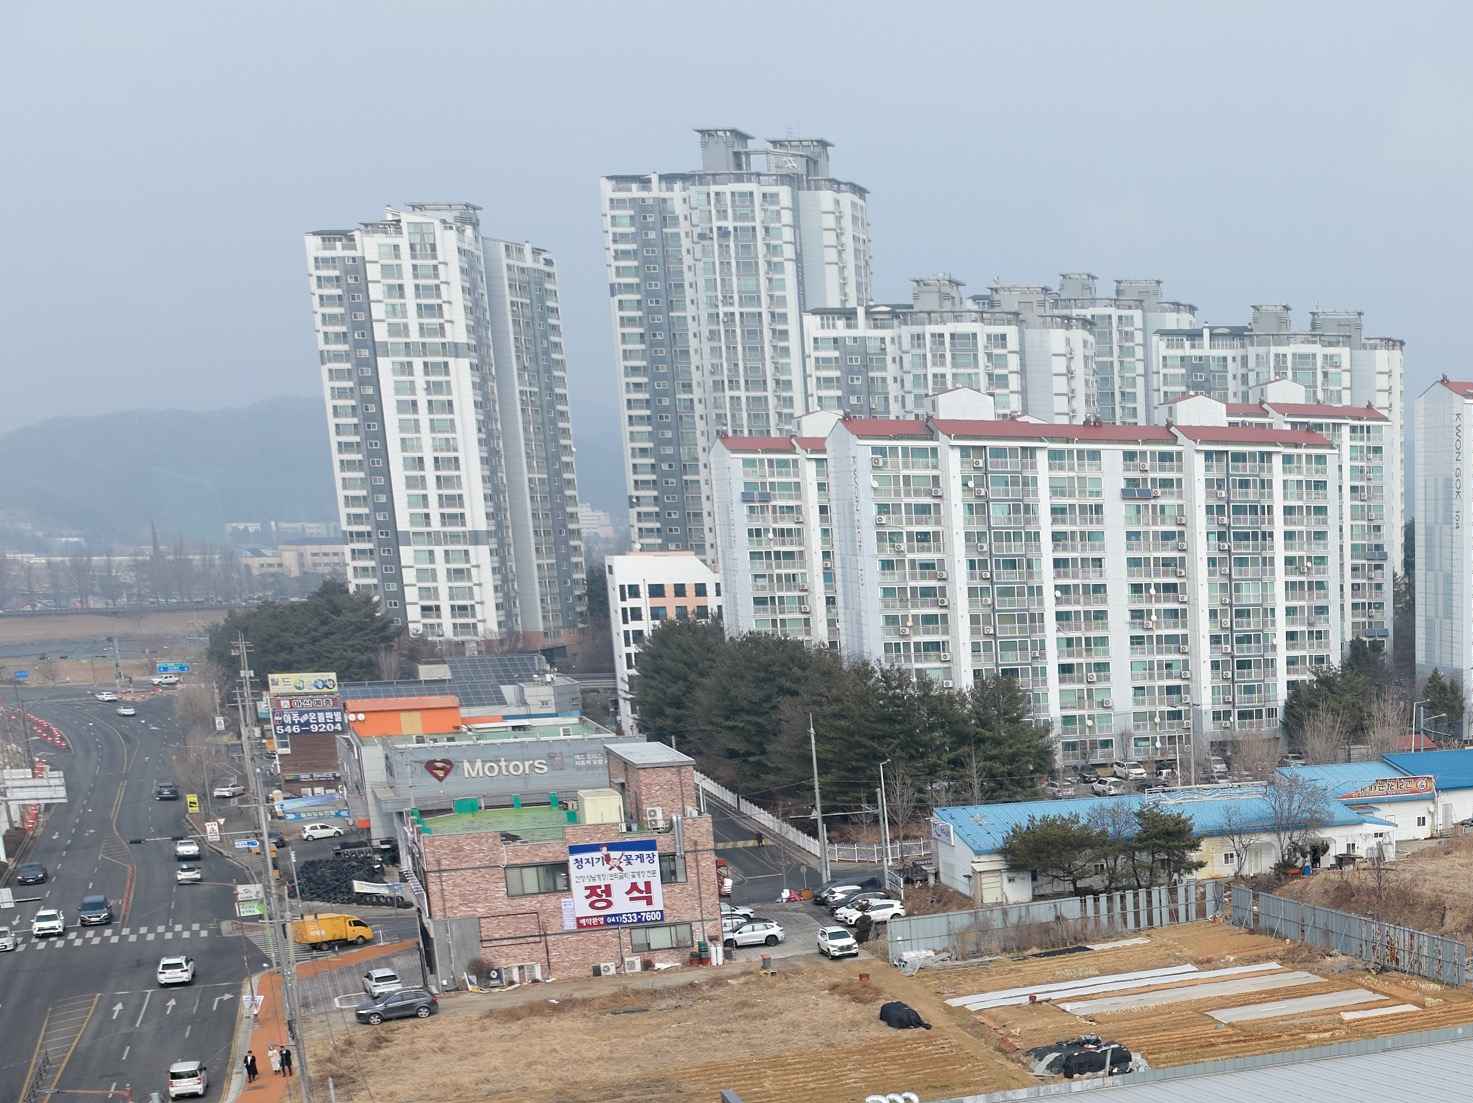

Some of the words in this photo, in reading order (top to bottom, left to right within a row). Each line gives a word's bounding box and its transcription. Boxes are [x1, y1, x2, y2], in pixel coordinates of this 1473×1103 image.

[276, 723, 342, 734] 546-9204
[463, 758, 549, 778] Motors
[574, 856, 605, 870] 청지기
[623, 852, 656, 866] 꽃게장
